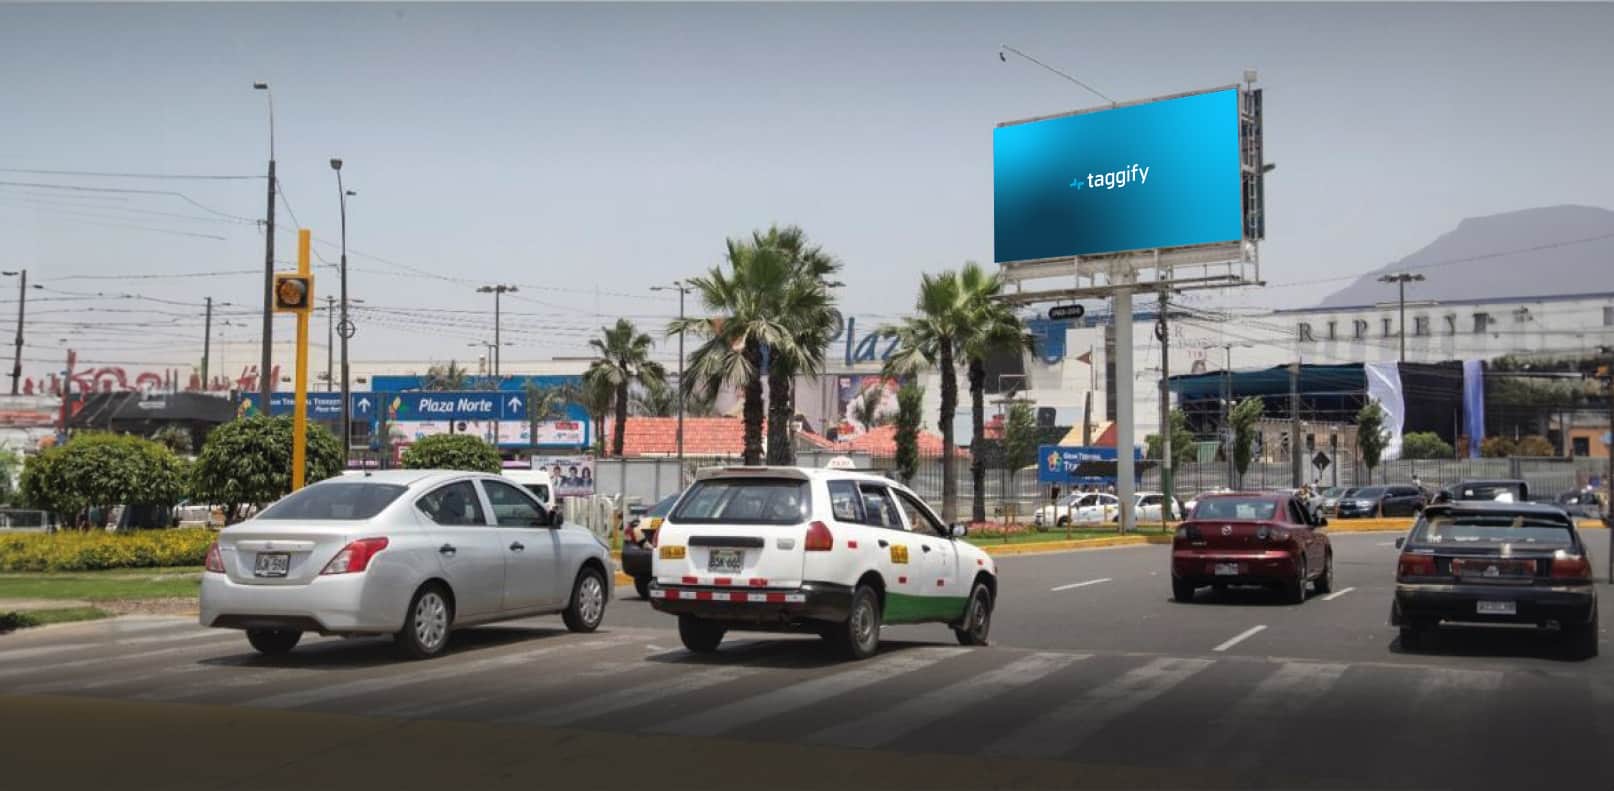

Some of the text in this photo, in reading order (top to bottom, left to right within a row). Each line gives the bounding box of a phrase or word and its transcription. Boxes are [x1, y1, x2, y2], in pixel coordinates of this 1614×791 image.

[1087, 163, 1149, 189] taggify
[1297, 313, 1457, 344] RIPLEY
[419, 397, 493, 413] Plaza Norte
